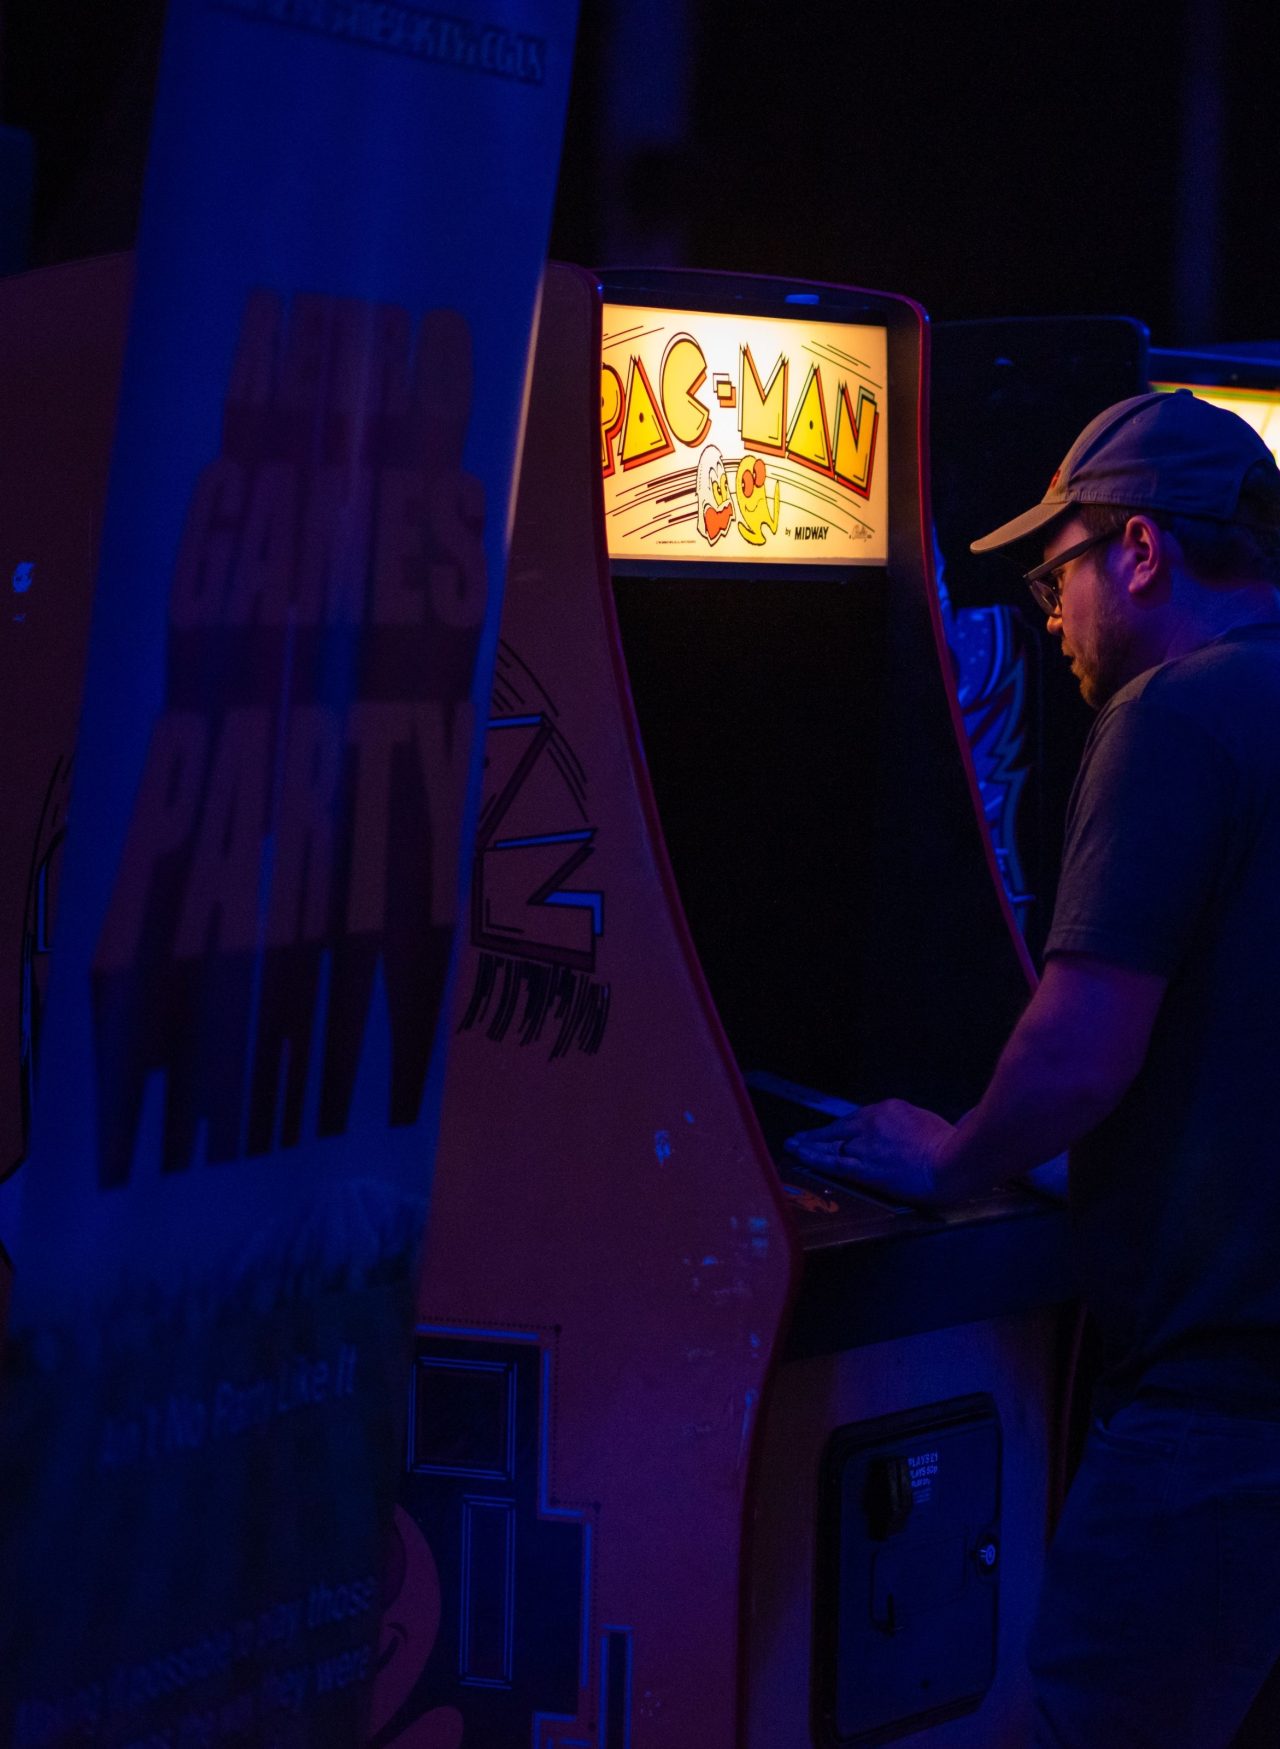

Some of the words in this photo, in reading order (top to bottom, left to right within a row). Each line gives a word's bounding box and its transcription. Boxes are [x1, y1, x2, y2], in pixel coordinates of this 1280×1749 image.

[170, 461, 488, 627] GAMES
[785, 528, 791, 536] by
[794, 526, 829, 540] MIDWAY
[90, 700, 476, 974] PARTY
